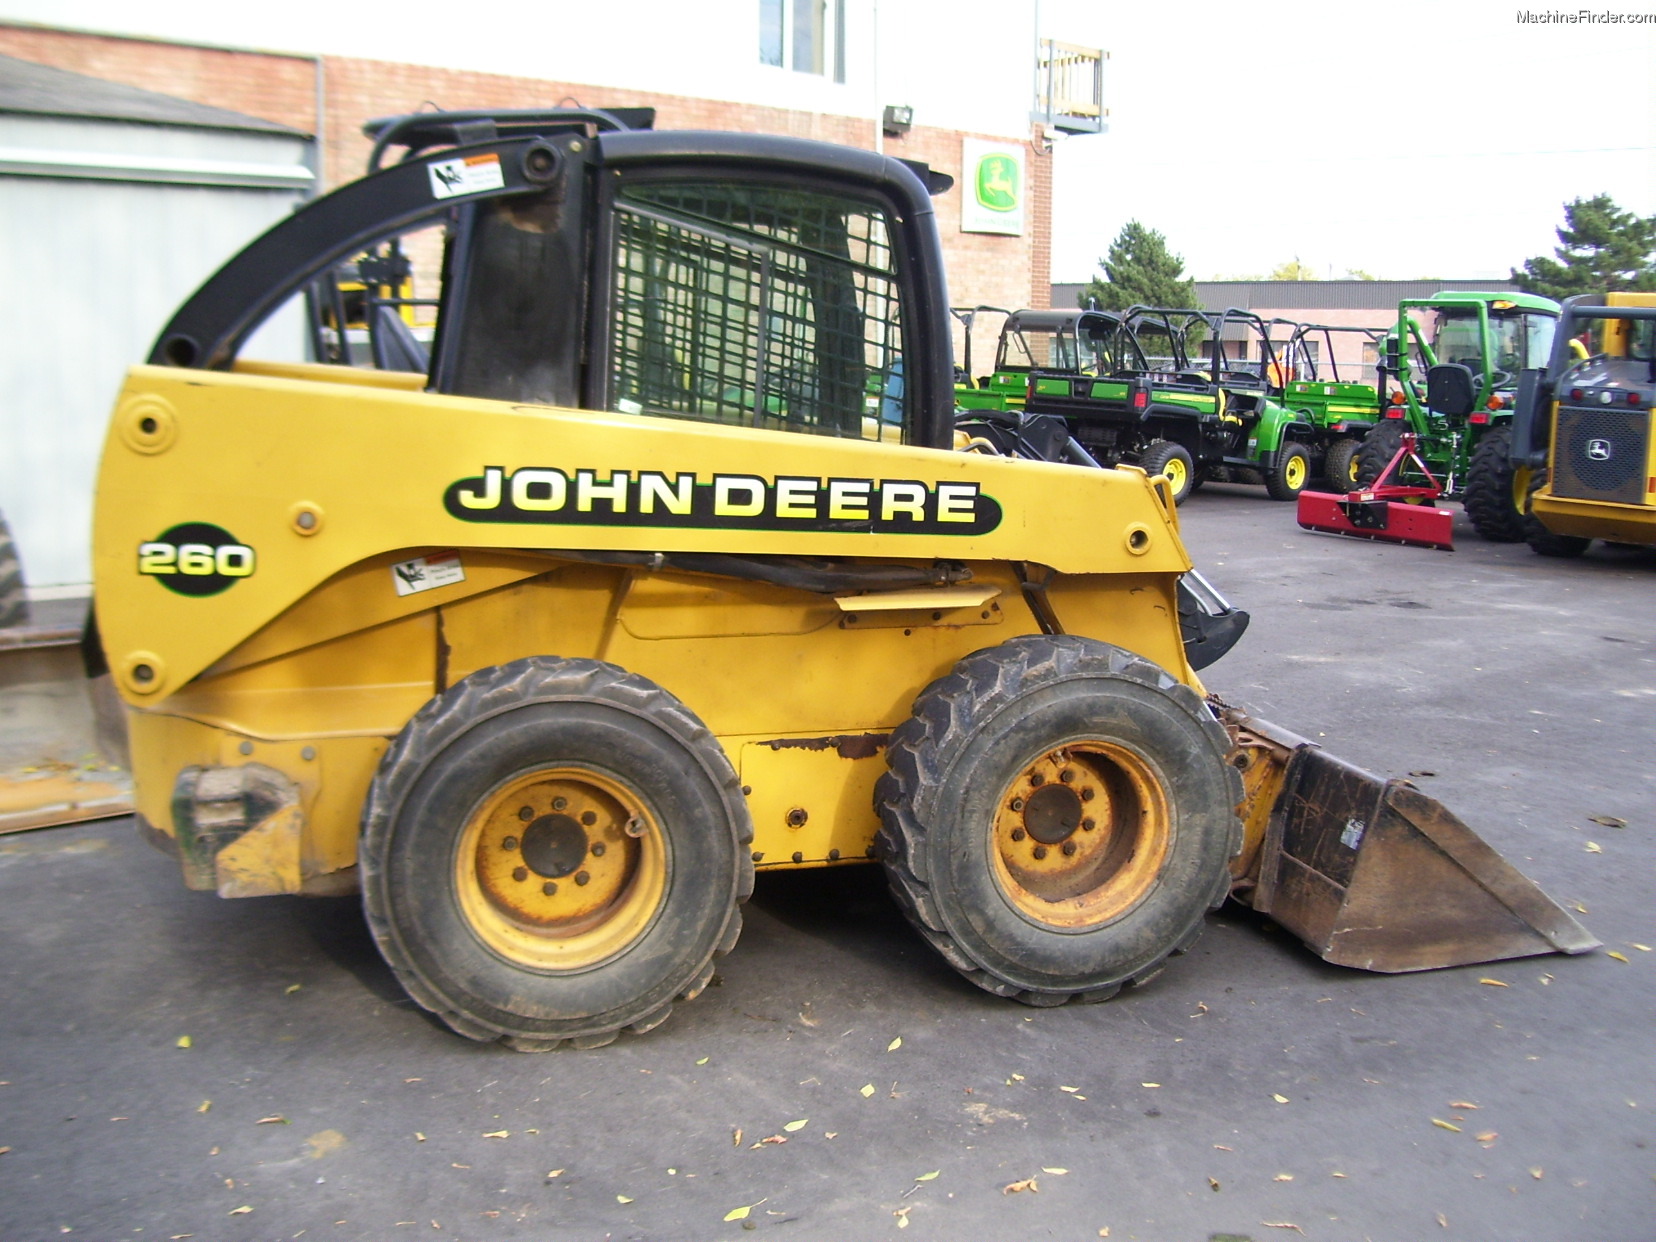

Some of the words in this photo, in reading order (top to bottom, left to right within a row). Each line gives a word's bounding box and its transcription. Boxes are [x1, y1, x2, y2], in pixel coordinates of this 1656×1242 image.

[458, 468, 694, 515] JOHN
[713, 474, 977, 523] DEERE
[139, 542, 255, 577] 260
